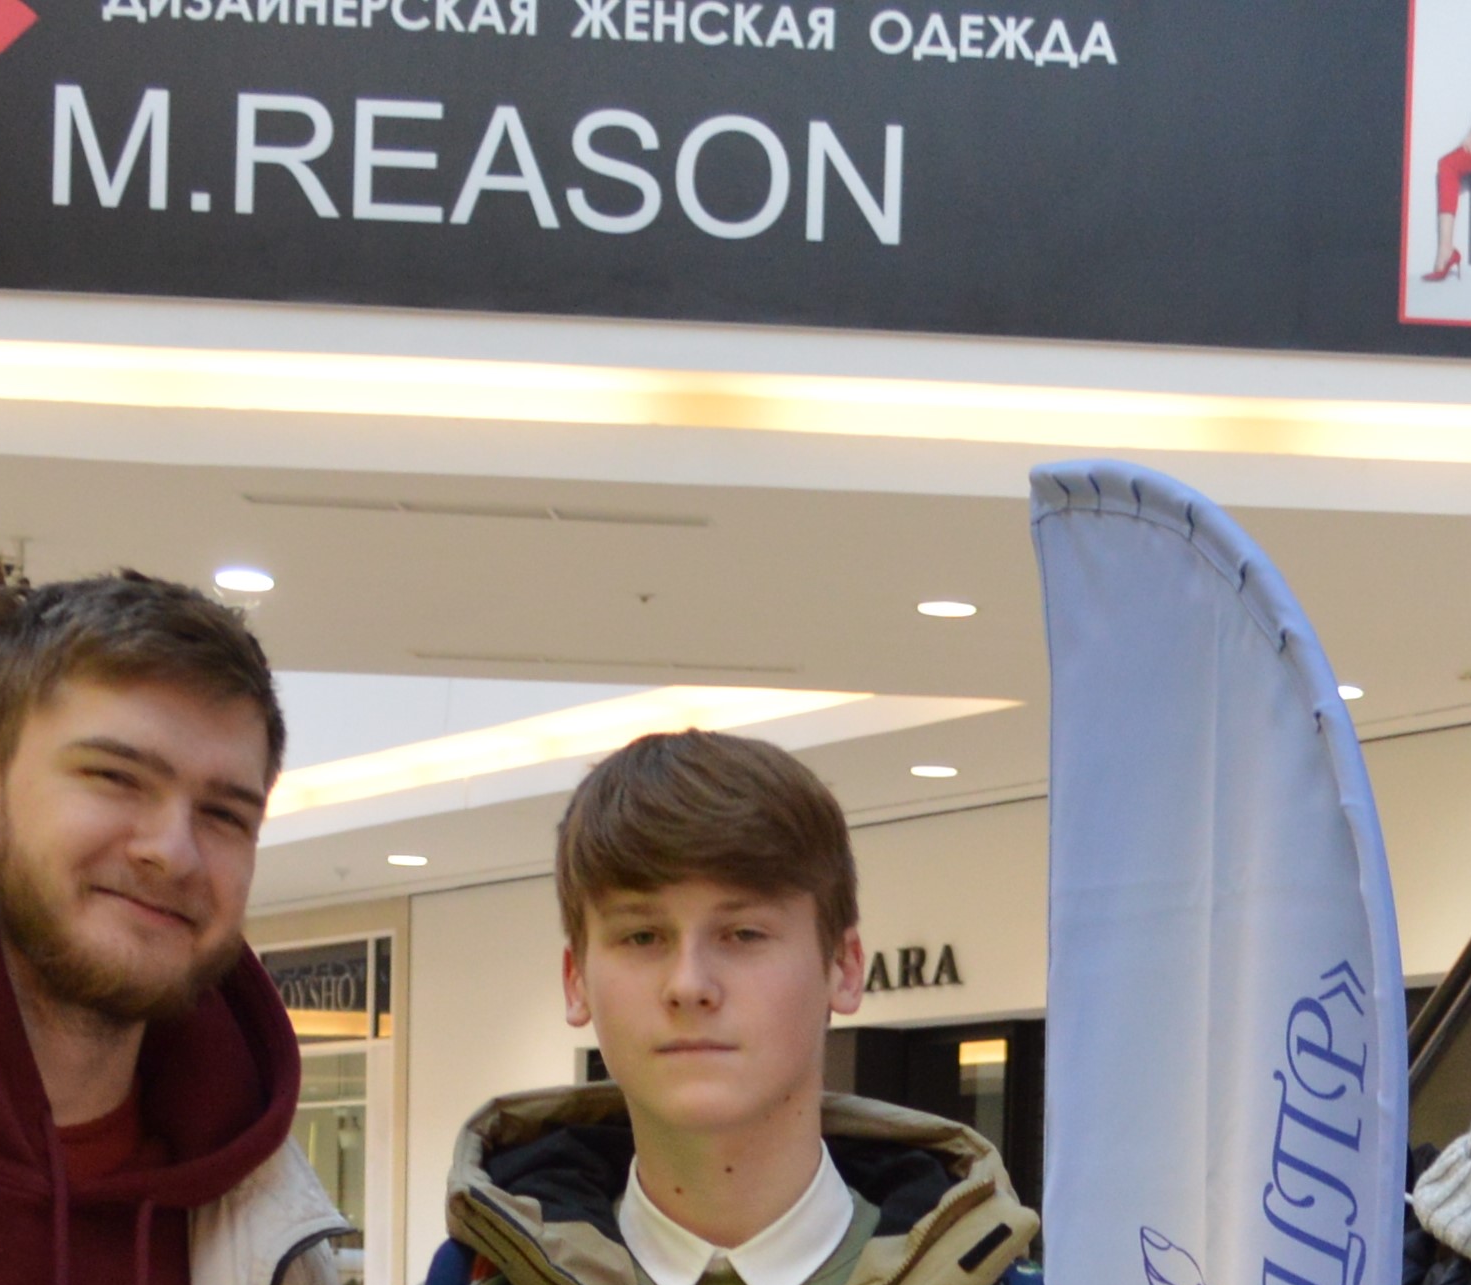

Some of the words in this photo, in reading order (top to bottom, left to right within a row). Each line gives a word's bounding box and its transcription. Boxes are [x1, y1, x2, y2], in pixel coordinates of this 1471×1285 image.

[570, 0, 836, 51] ЖЕНСКАЯ
[868, 9, 1119, 69] ОДЕЖДА
[49, 82, 905, 247] M.REASON
[864, 943, 964, 993] ARA
